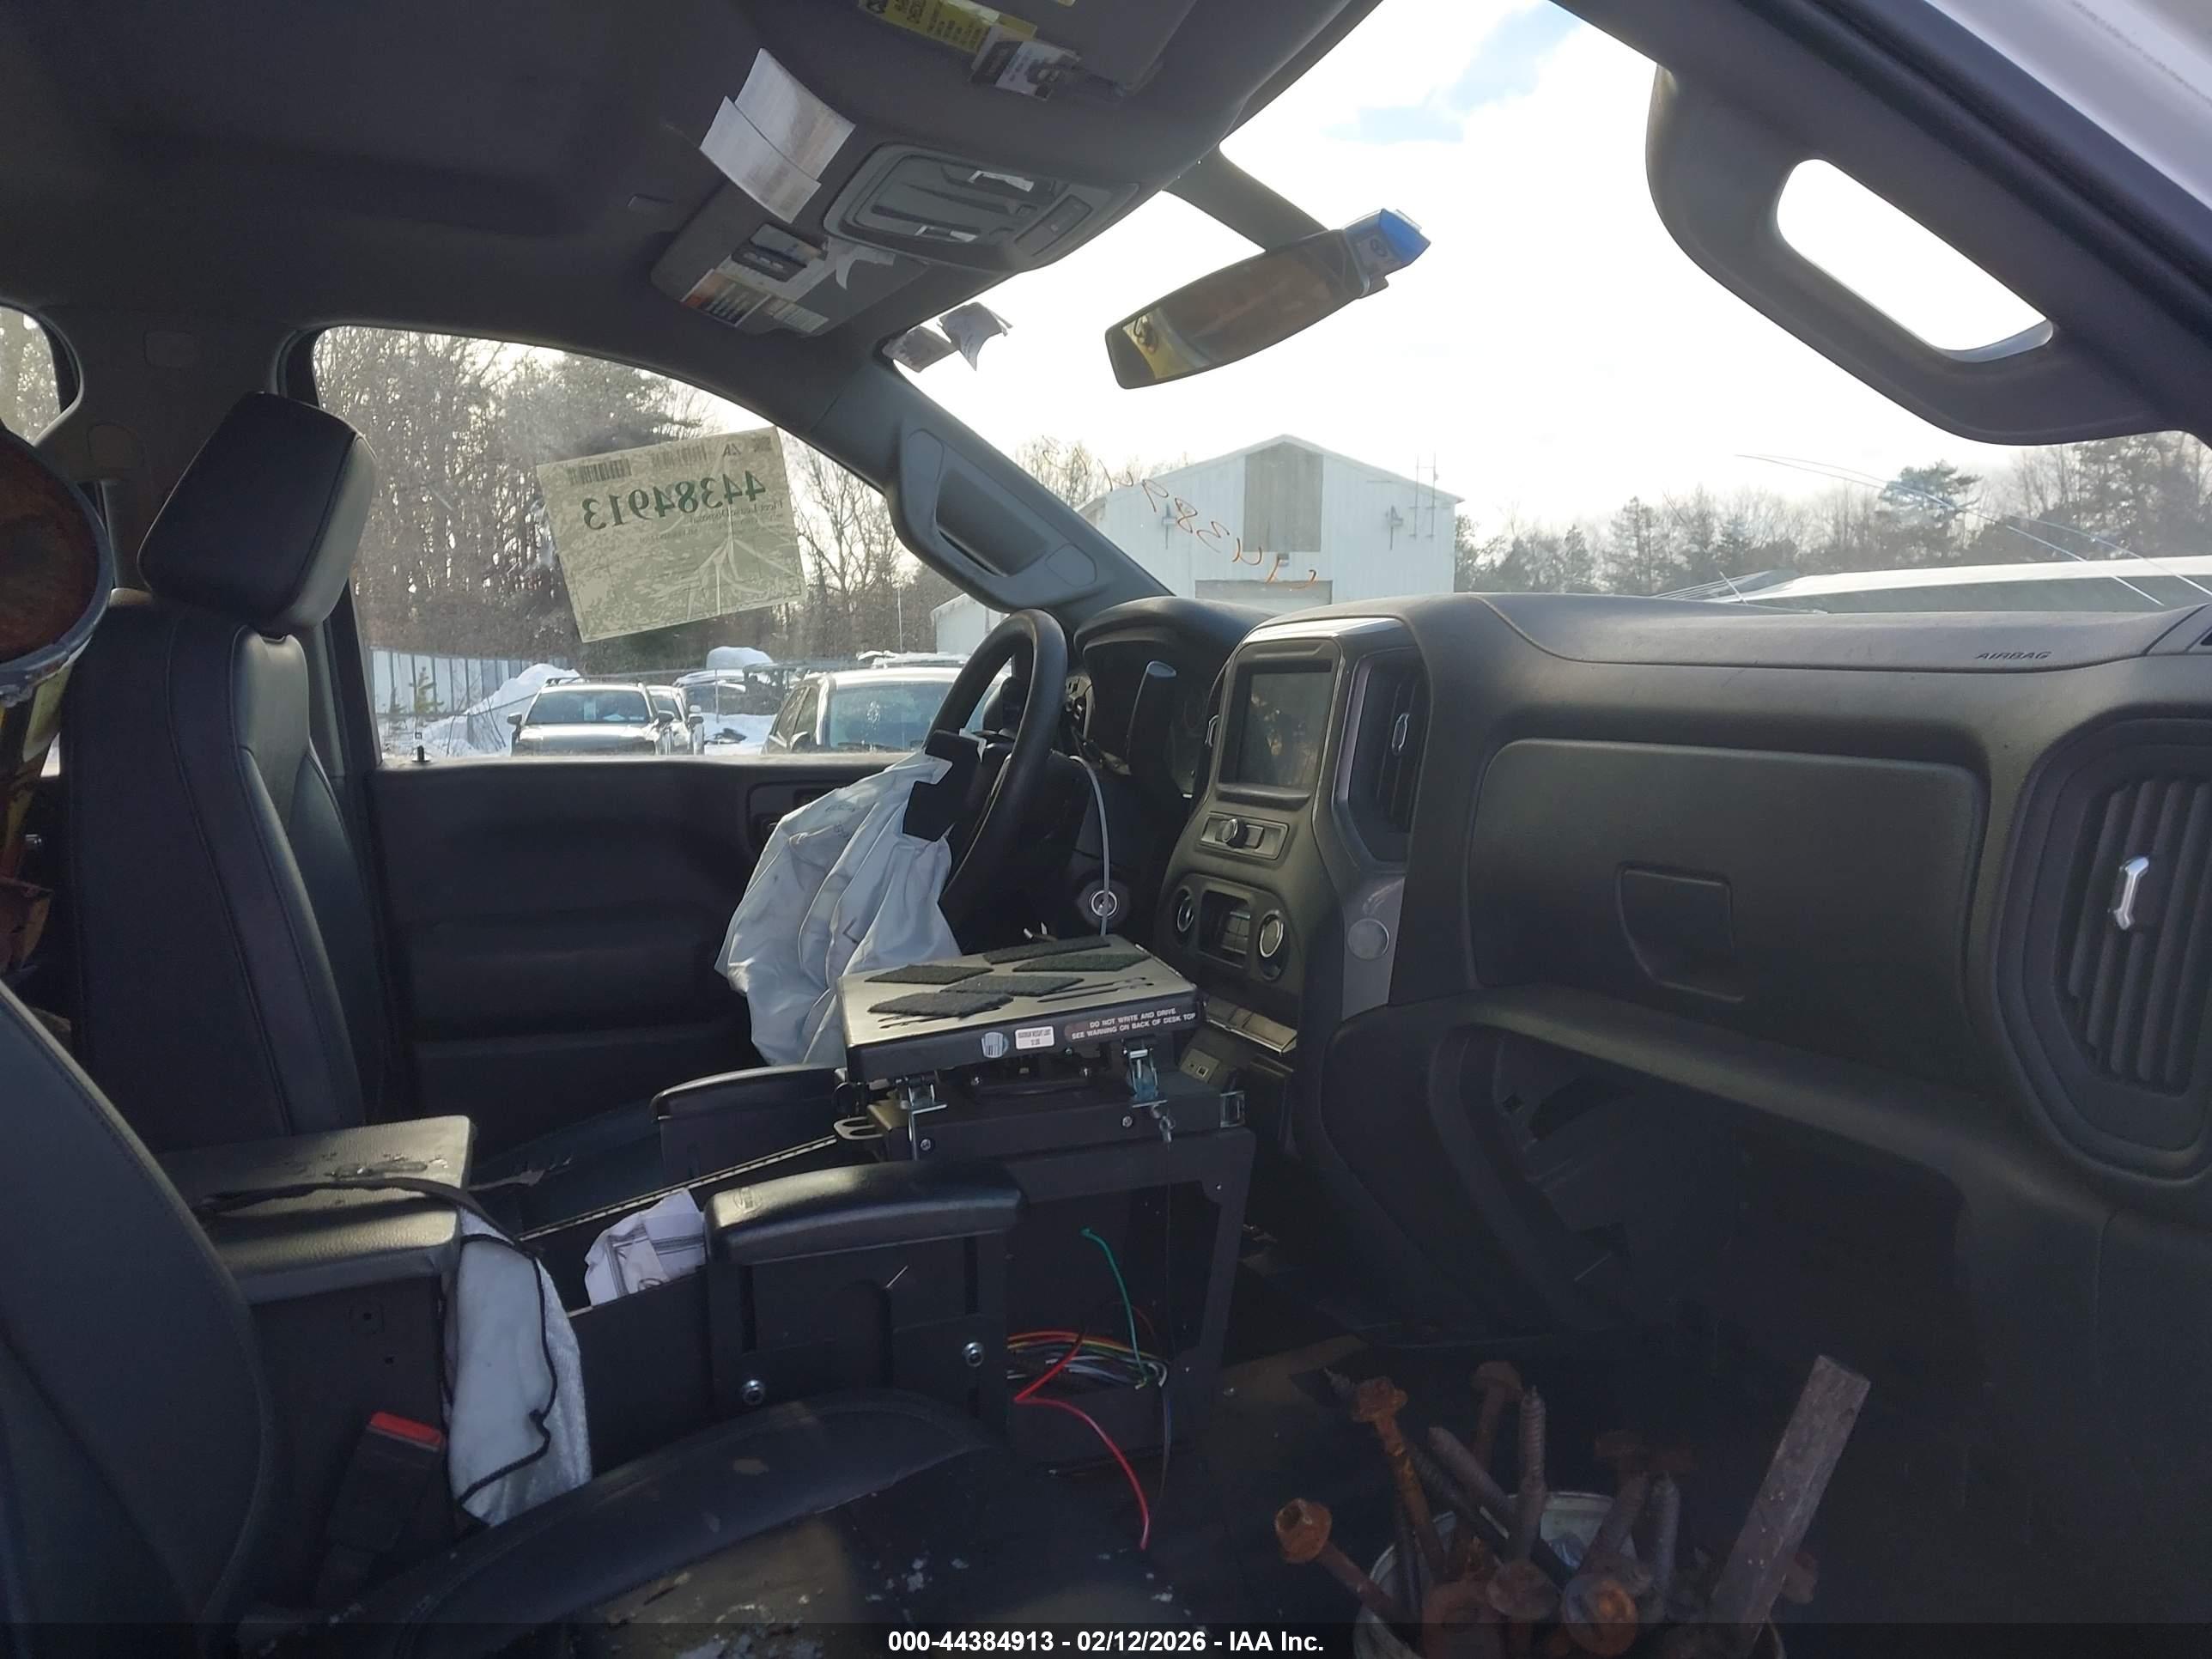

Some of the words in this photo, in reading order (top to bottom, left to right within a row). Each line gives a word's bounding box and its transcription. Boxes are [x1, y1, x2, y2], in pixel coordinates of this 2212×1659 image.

[1974, 651, 2052, 660] AIRBAG
[1086, 1026, 1117, 1037] WARNING
[1132, 1021, 1150, 1030] BACK
[1164, 1016, 1182, 1024] DESK
[1183, 1012, 1196, 1021] TOP
[1102, 1018, 1115, 1026] NOT
[1117, 1014, 1139, 1024] WRITE
[1157, 1008, 1176, 1017] DRIVE
